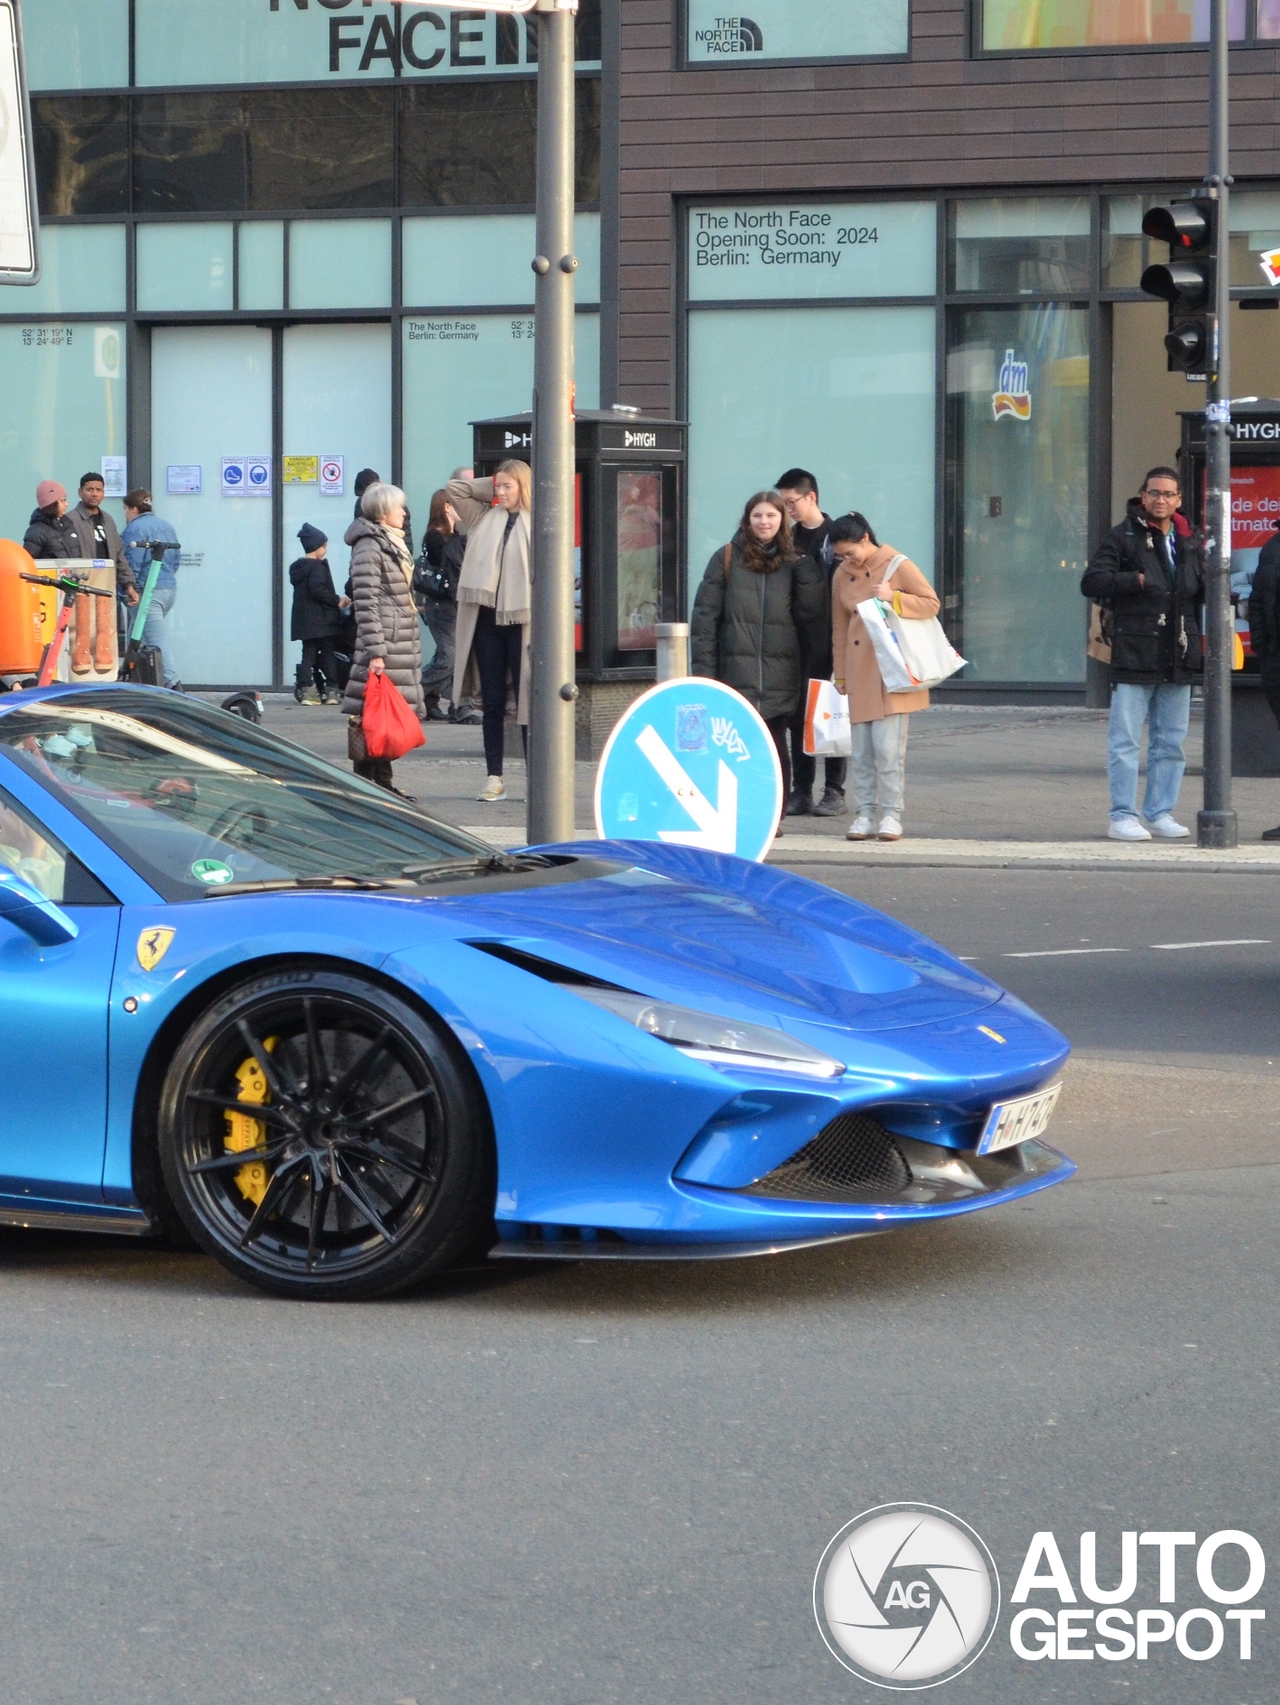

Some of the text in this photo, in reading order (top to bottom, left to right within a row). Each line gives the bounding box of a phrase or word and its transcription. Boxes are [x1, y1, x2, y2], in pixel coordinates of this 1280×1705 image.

[714, 17, 739, 29] THE
[328, 11, 487, 72] FACE
[695, 29, 739, 42] NORTH
[706, 41, 739, 53] FACE
[696, 210, 832, 229] The North Face
[696, 227, 879, 251] Opening Soon: 2024
[696, 248, 842, 267] Berlin: Germany
[66, 328, 73, 337] N
[408, 321, 477, 331] The North Face
[66, 337, 73, 346] E
[408, 330, 479, 341] Berlin: Germany
[1001, 352, 1028, 394] dm
[633, 432, 656, 447] HYGH
